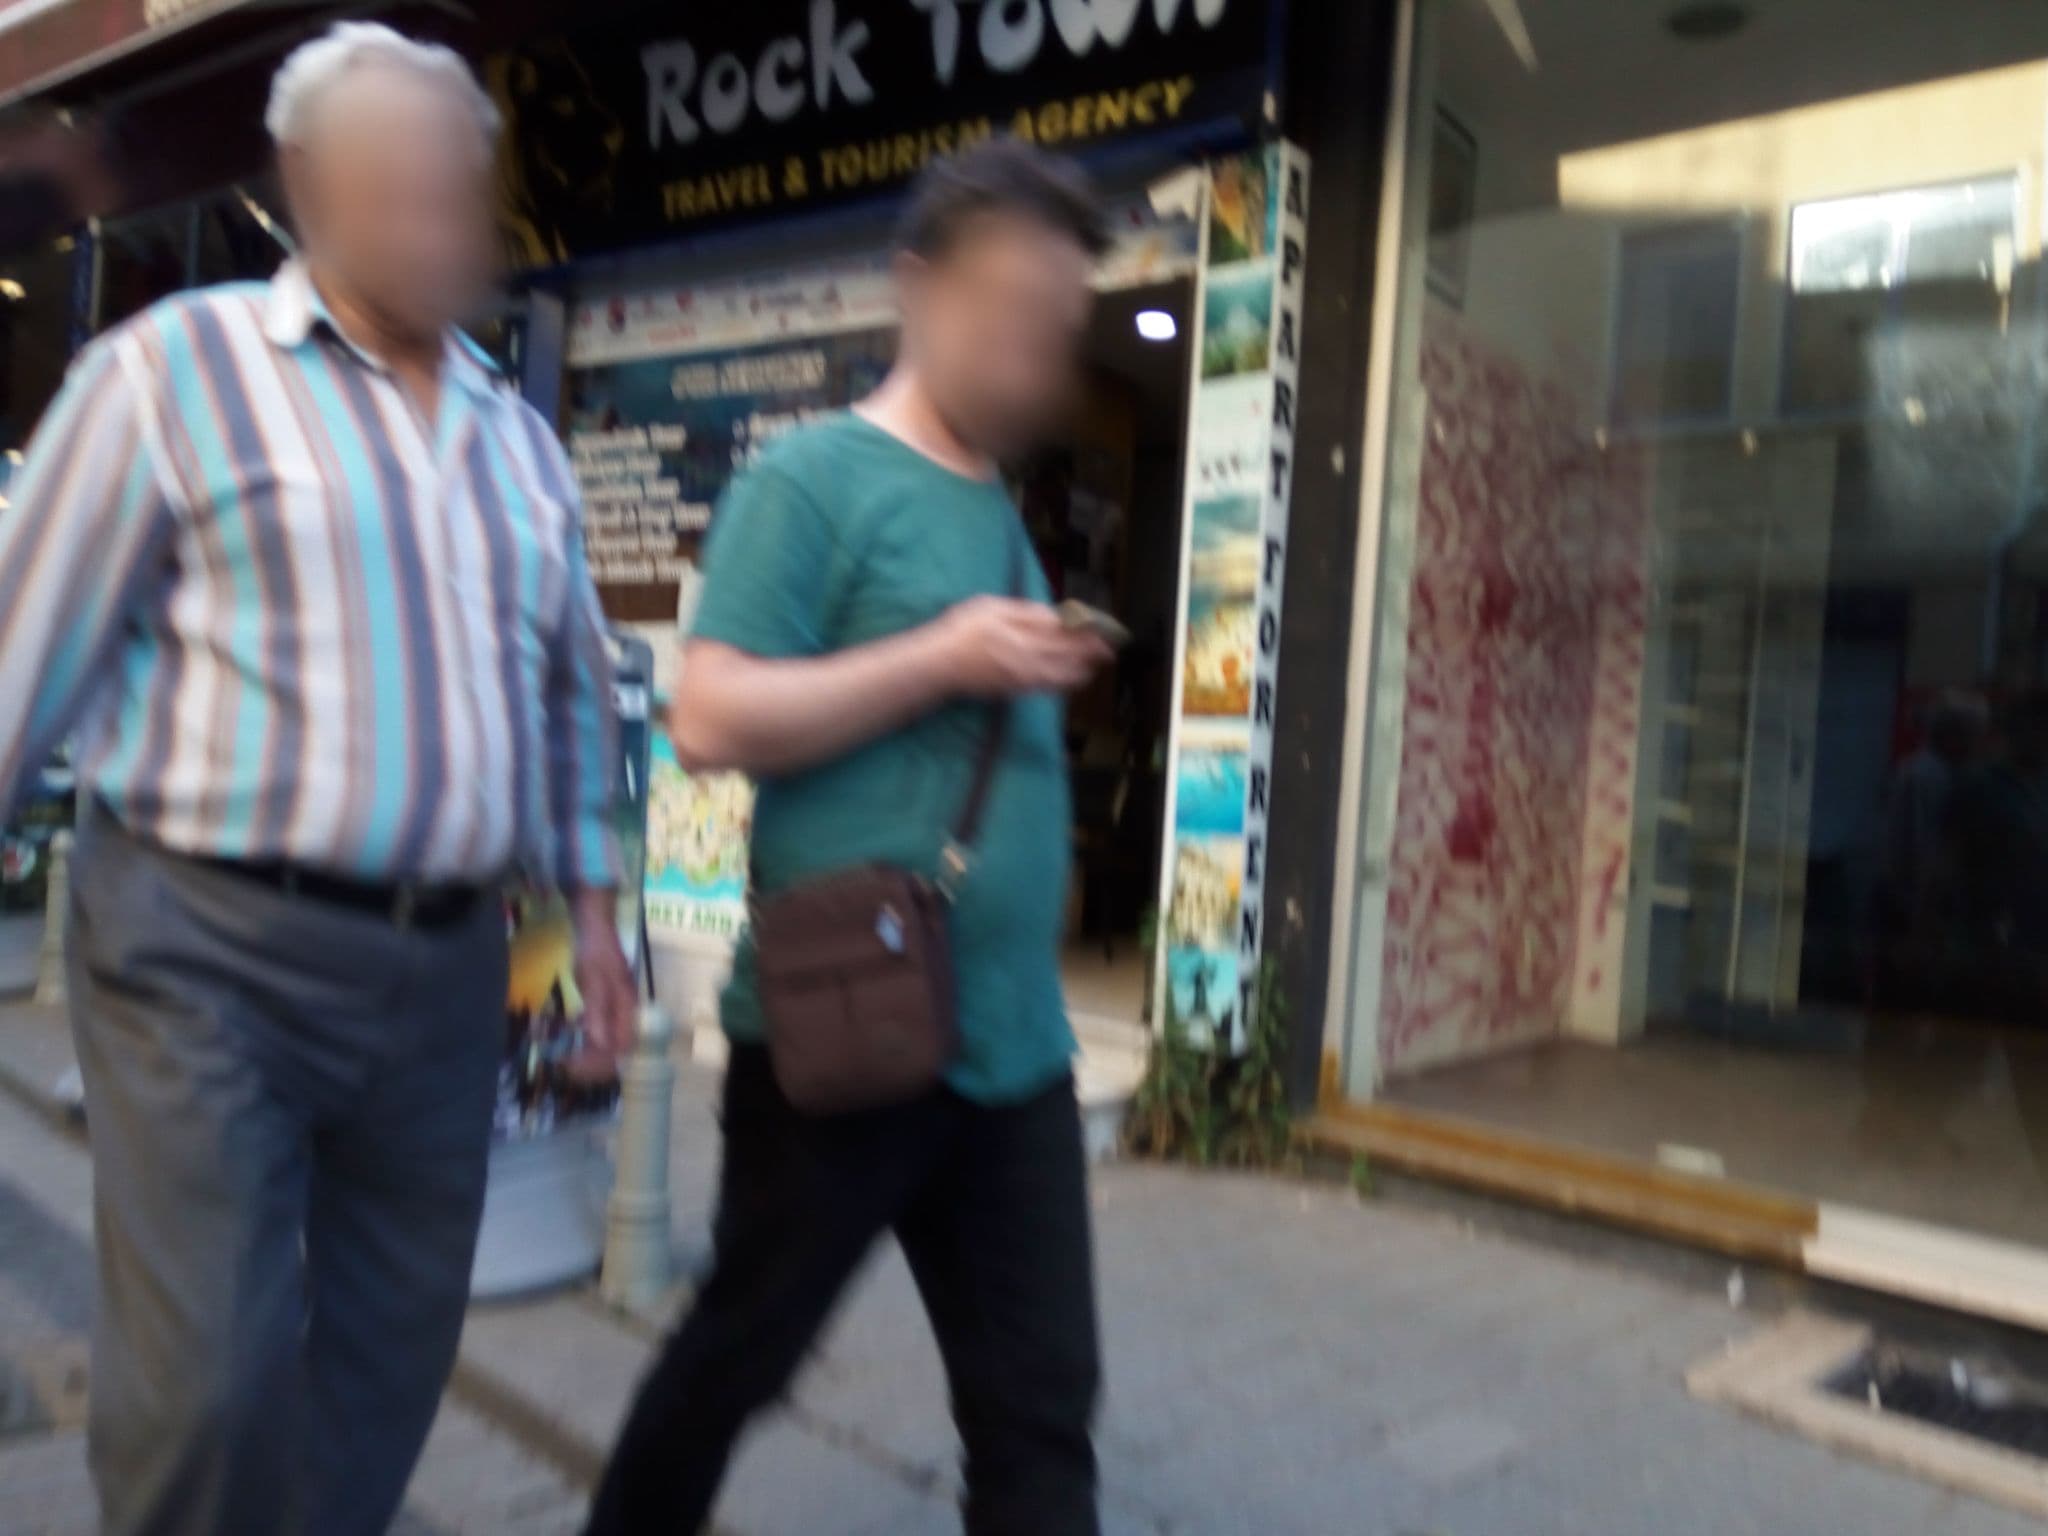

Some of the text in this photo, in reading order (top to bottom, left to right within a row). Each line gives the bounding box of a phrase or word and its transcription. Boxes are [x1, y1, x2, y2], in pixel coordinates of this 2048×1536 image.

[662, 162, 773, 221] TRAVEL
[783, 154, 808, 198] &
[1009, 74, 1195, 144] AGENCY
